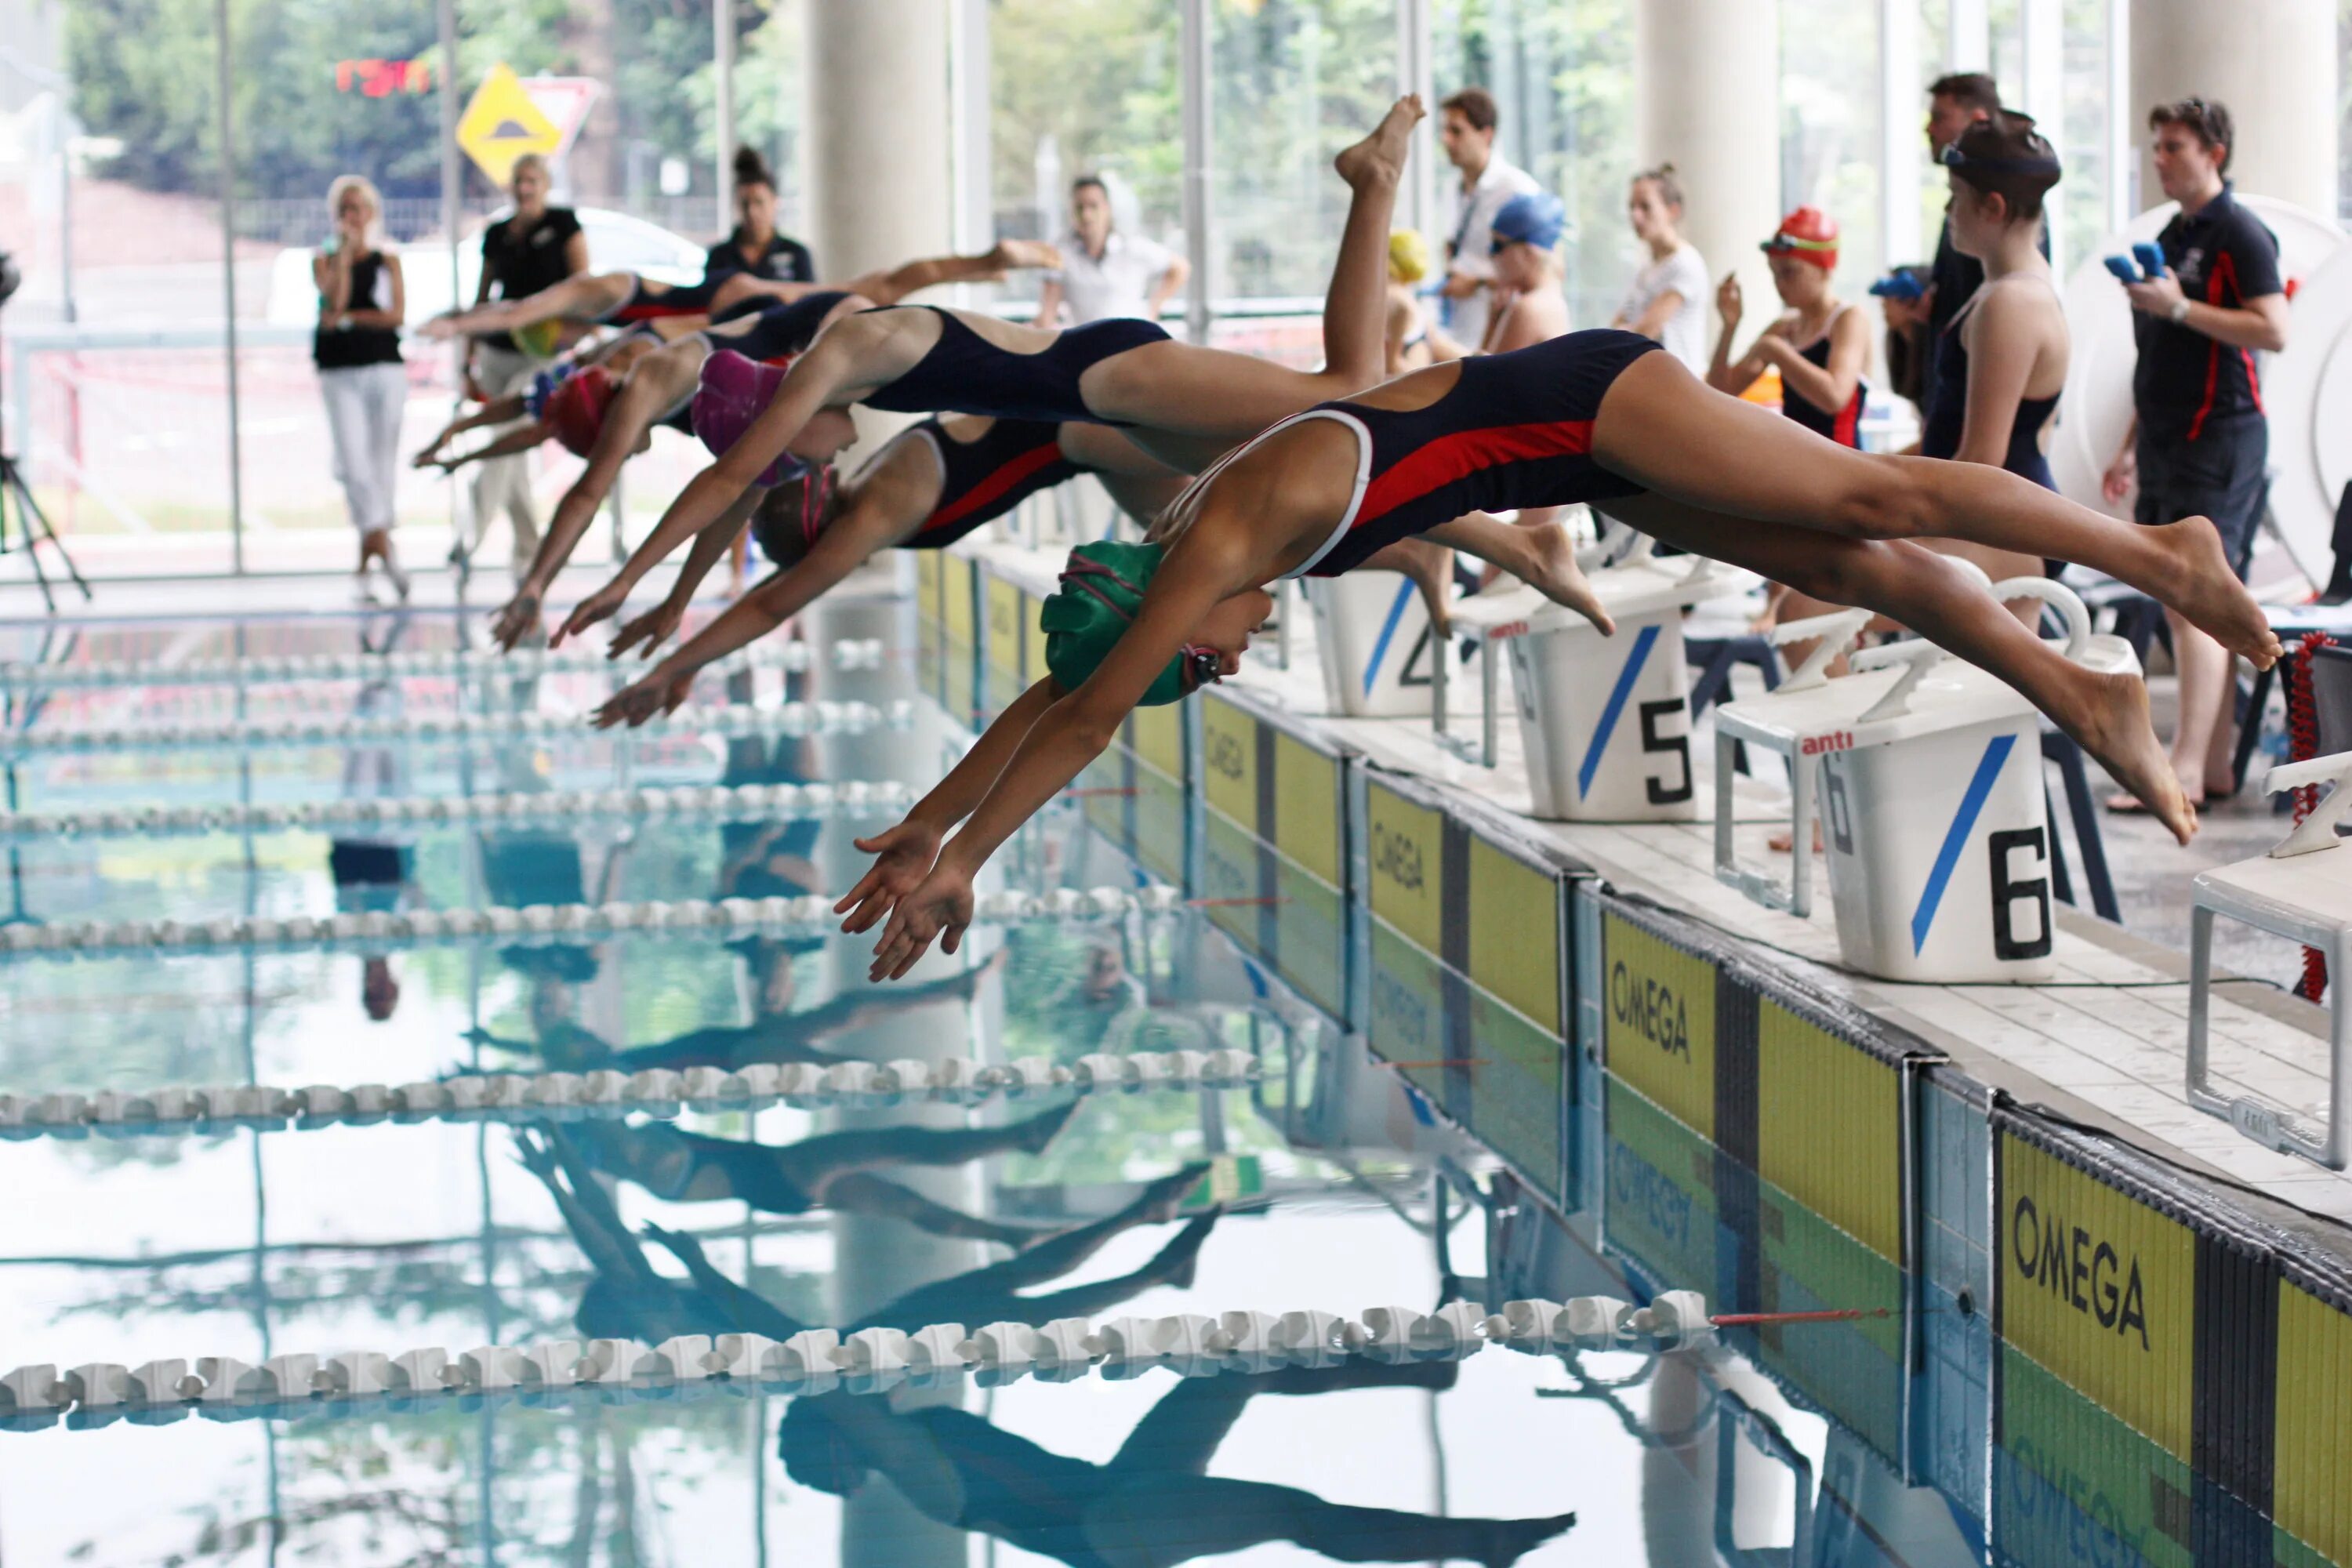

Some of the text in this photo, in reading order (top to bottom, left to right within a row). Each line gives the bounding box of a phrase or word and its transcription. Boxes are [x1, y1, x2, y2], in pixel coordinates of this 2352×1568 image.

[1639, 698, 1692, 804] 5
[1802, 730, 1853, 755] anti
[1989, 826, 2052, 961] 6
[1613, 960, 1691, 1064] OMEGA
[2013, 1195, 2150, 1352] OMEGA
